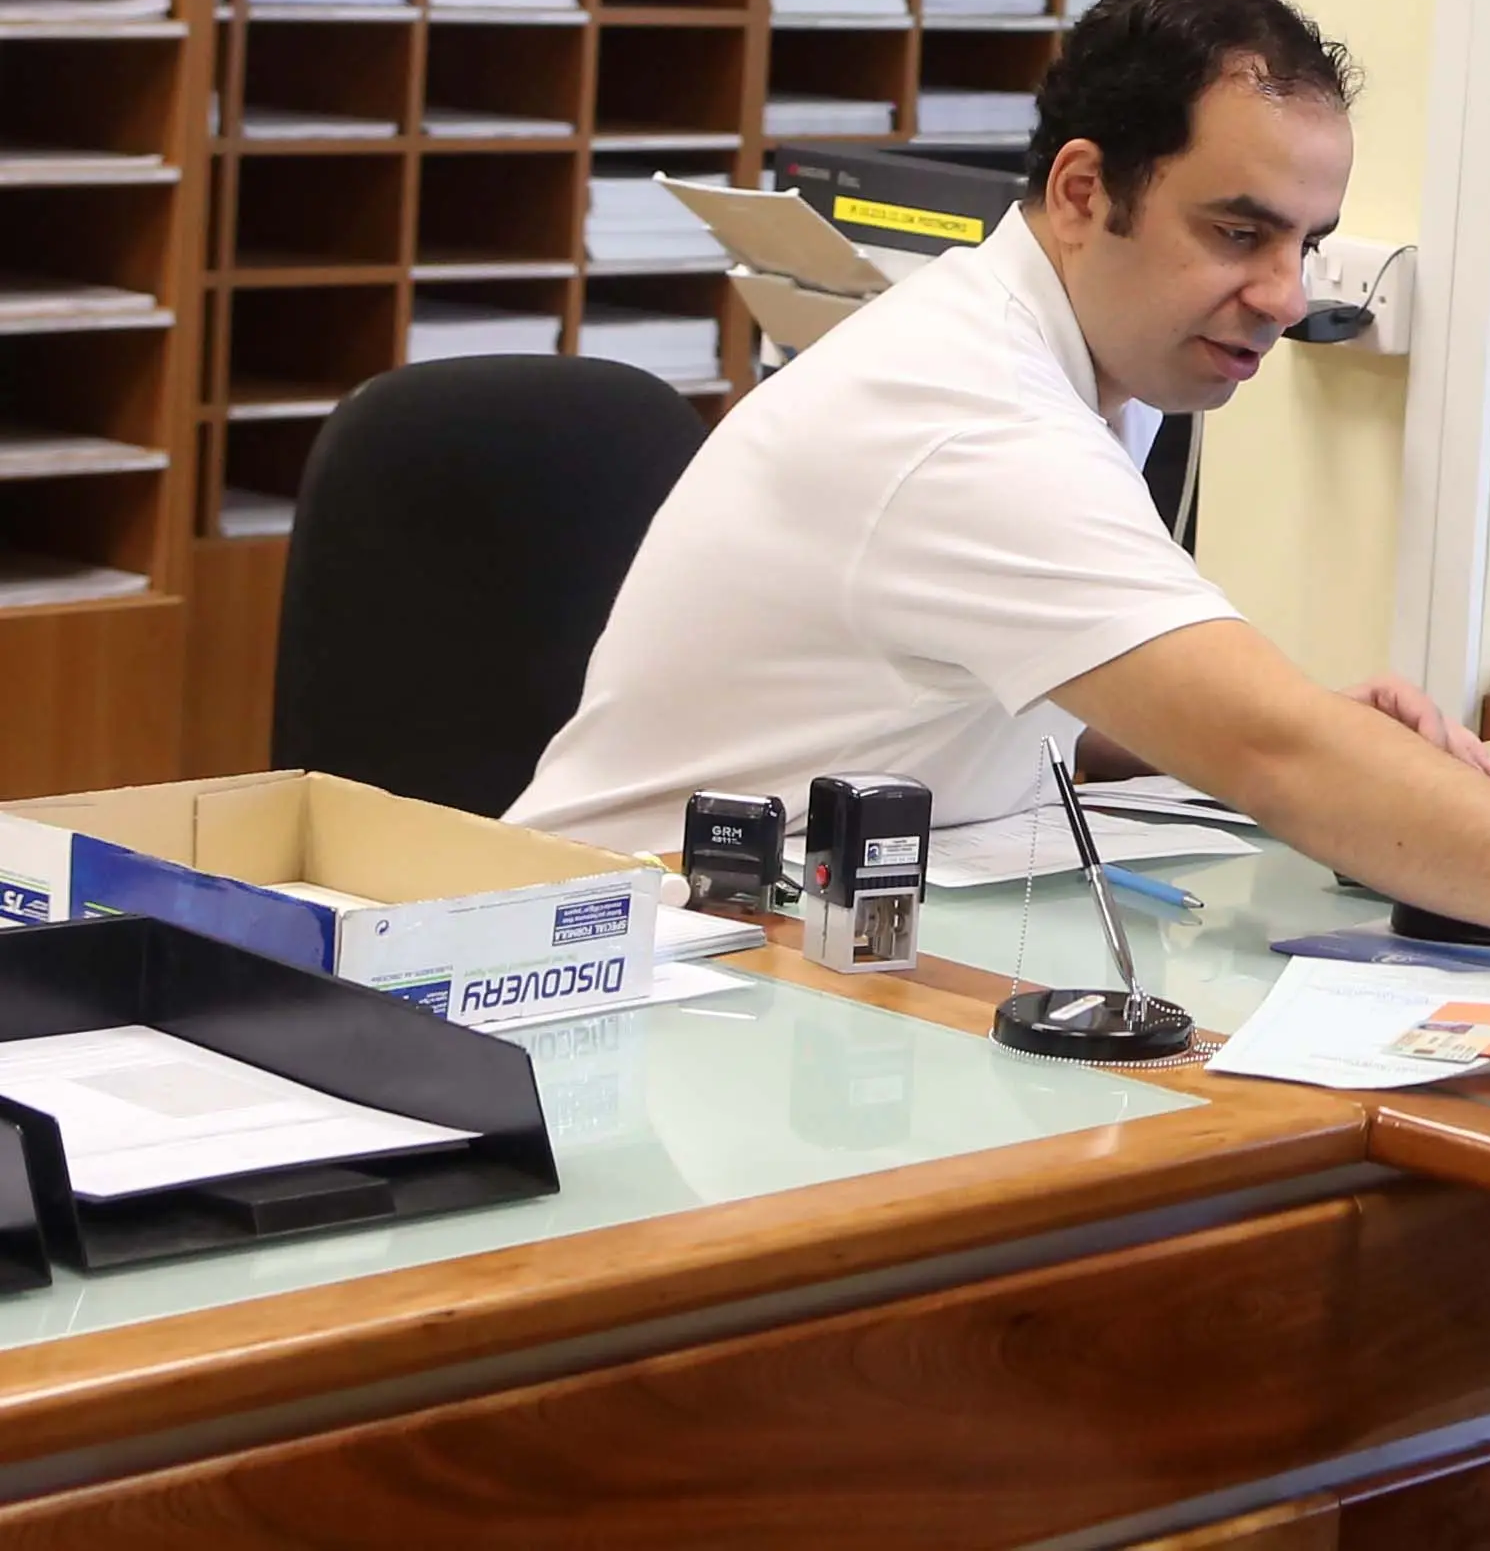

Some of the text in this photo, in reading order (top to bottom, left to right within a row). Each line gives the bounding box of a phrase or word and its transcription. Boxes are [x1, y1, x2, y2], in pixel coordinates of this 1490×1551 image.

[711, 825, 743, 839] GRM
[554, 919, 627, 941] SPECIAL FORMULA
[461, 956, 626, 1014] DISCOVERY
